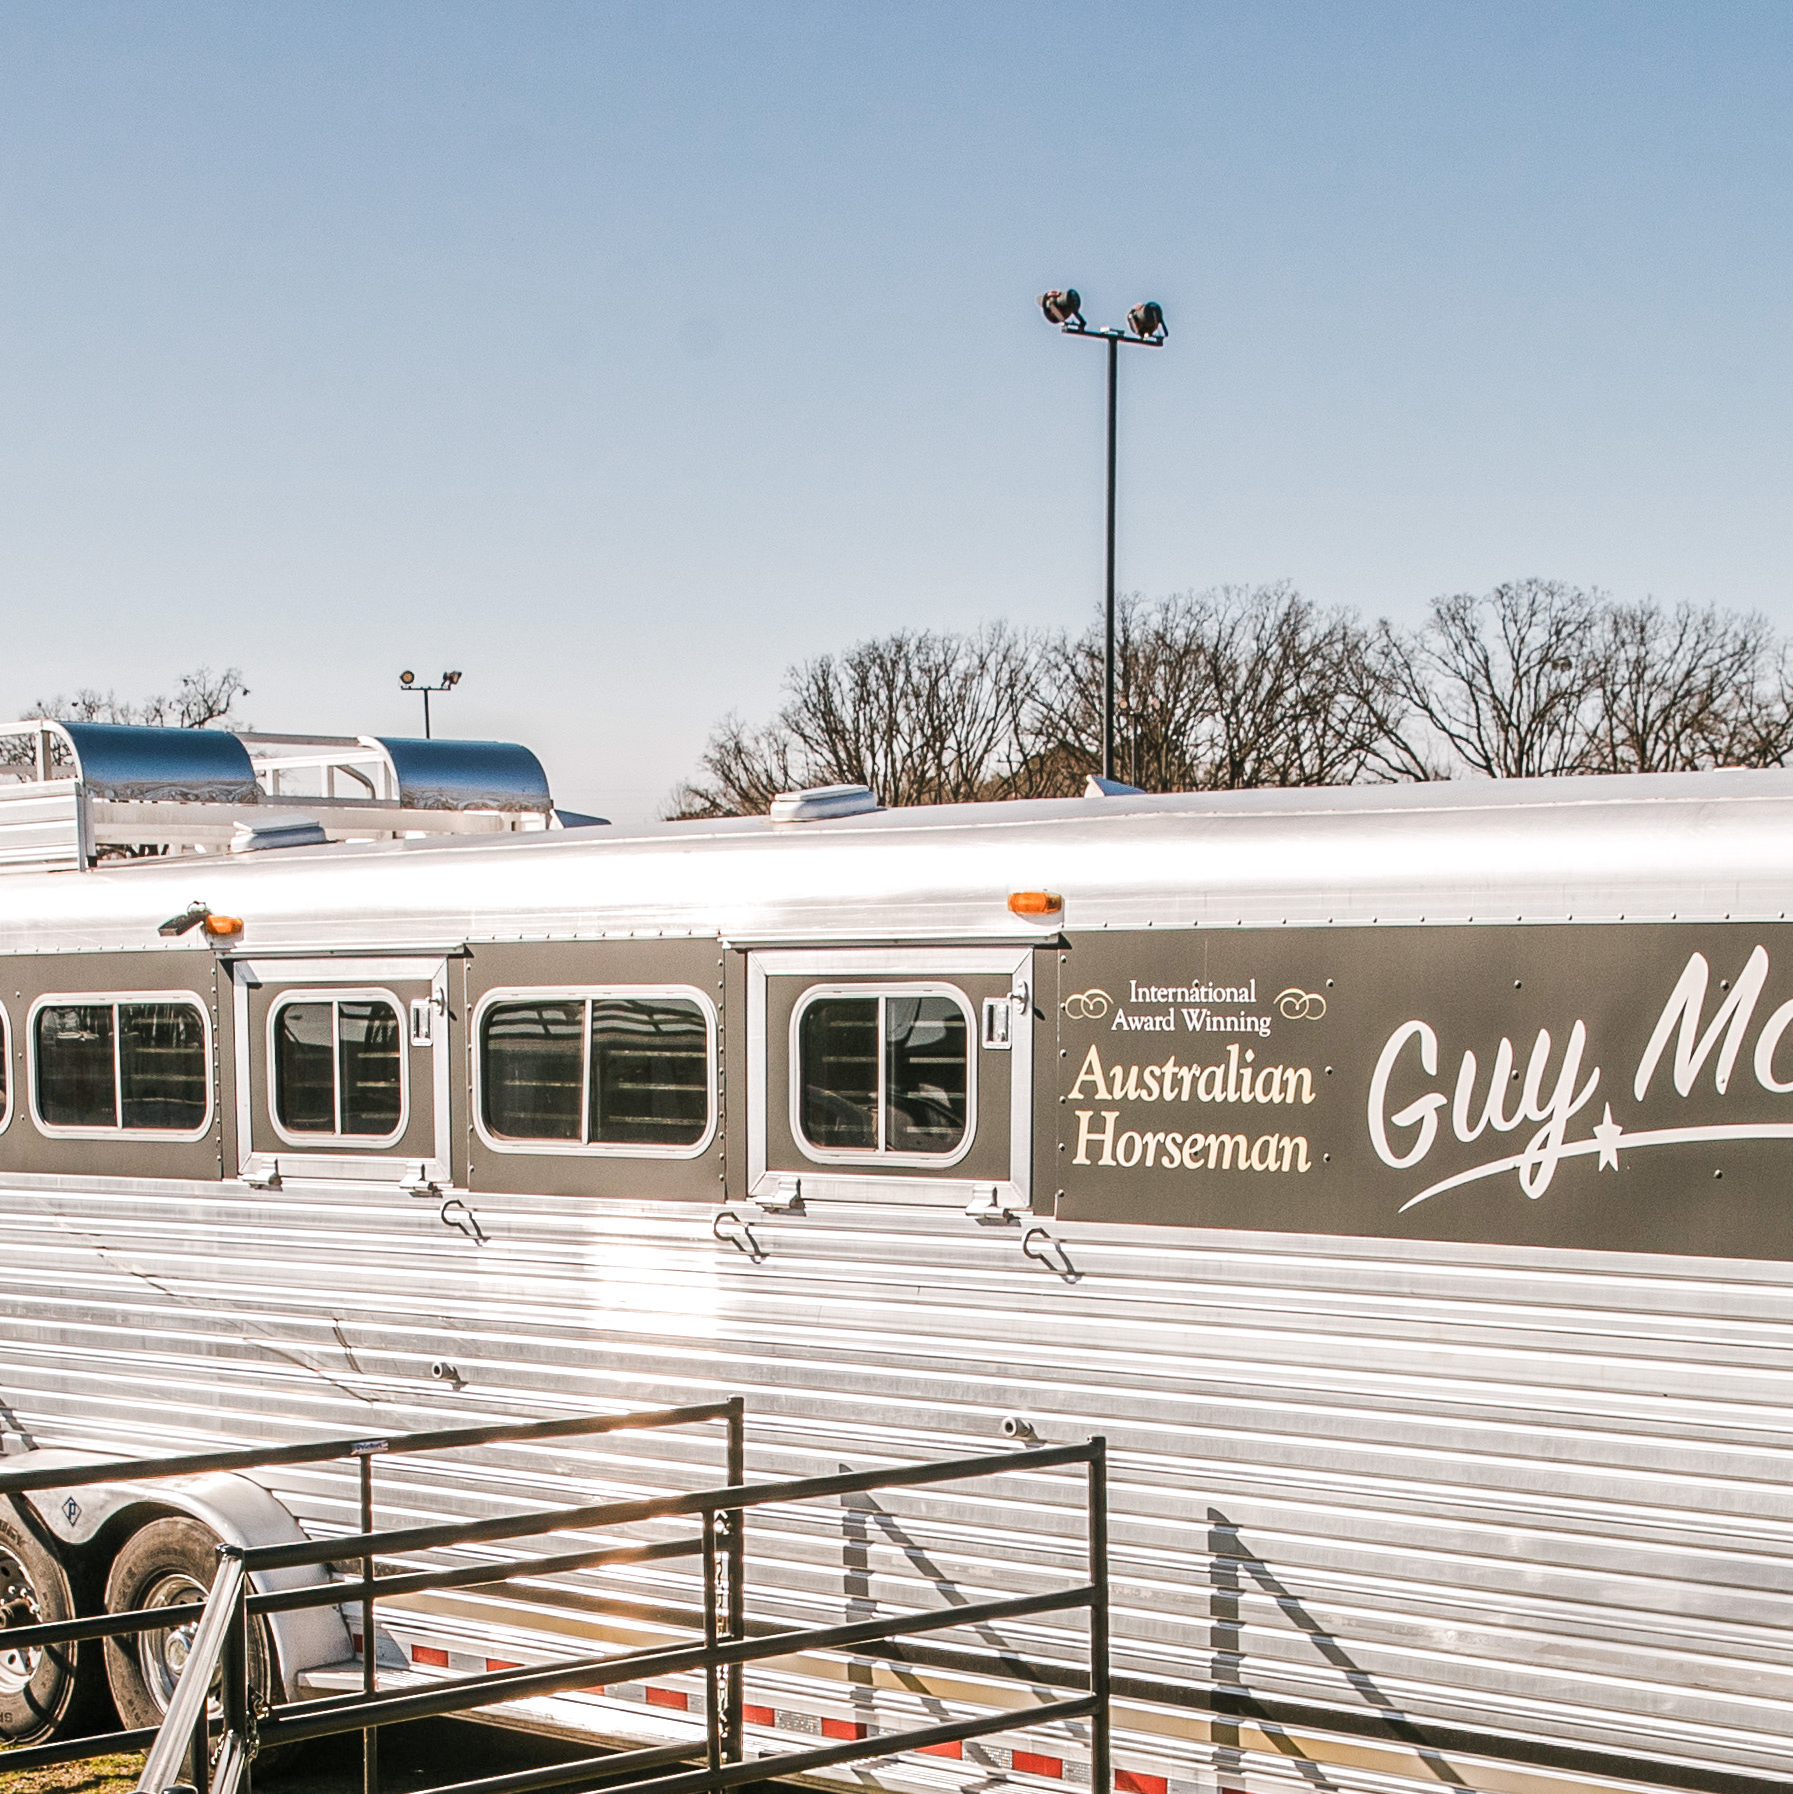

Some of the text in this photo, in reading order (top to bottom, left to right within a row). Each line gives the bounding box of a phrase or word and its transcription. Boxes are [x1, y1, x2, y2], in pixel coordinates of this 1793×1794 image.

[1129, 979, 1257, 1003] International
[1111, 1008, 1272, 1037] Award Winning
[1067, 1044, 1316, 1104] Australian
[1368, 1019, 1600, 1200] Guy
[1071, 1110, 1312, 1173] Horseman
